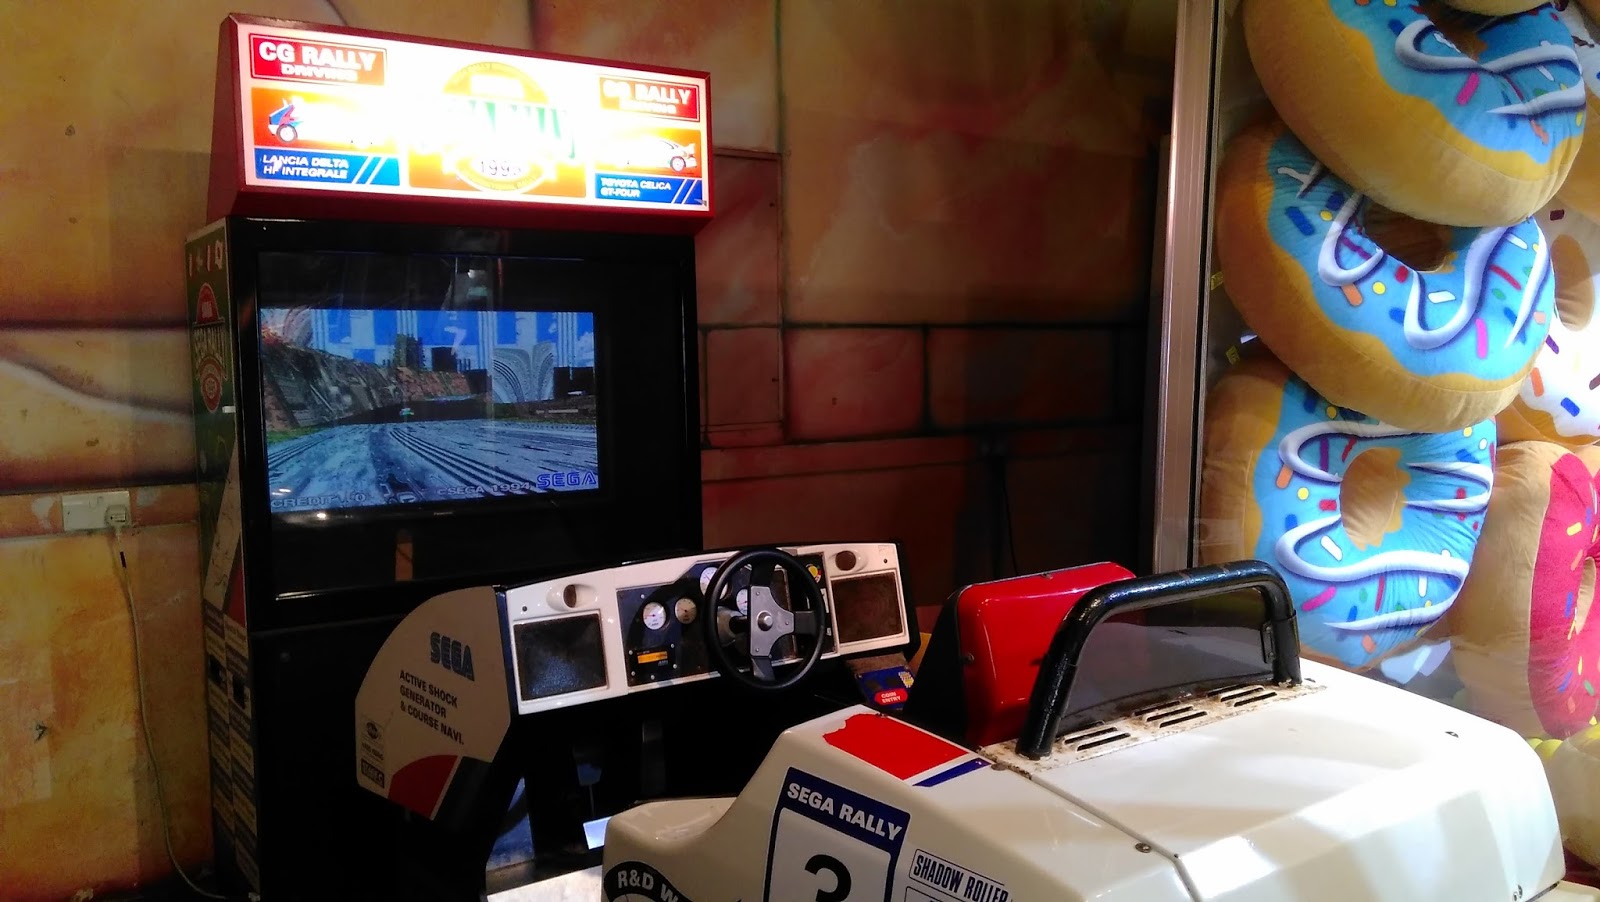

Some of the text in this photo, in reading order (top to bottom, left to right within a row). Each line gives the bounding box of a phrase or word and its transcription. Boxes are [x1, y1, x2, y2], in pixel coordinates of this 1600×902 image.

[259, 41, 377, 72] CG RALLY
[635, 83, 691, 105] RALLY
[262, 154, 349, 169] LANCIA DELTA
[281, 166, 348, 179] INTEGRALE
[600, 177, 672, 190] TOYOTA CELICA
[536, 470, 597, 489] SEGA
[270, 494, 334, 508] CREDIT
[430, 632, 475, 681] SEGA
[399, 669, 458, 709] ACTIVE SHOCK
[399, 684, 447, 718] GENERATOR
[399, 700, 407, 712] &
[407, 704, 439, 731] COURSE
[440, 722, 465, 746] NAVI.
[787, 782, 903, 842] SEGA RALLY
[617, 869, 655, 891] R&D
[913, 854, 964, 893] SHADOW
